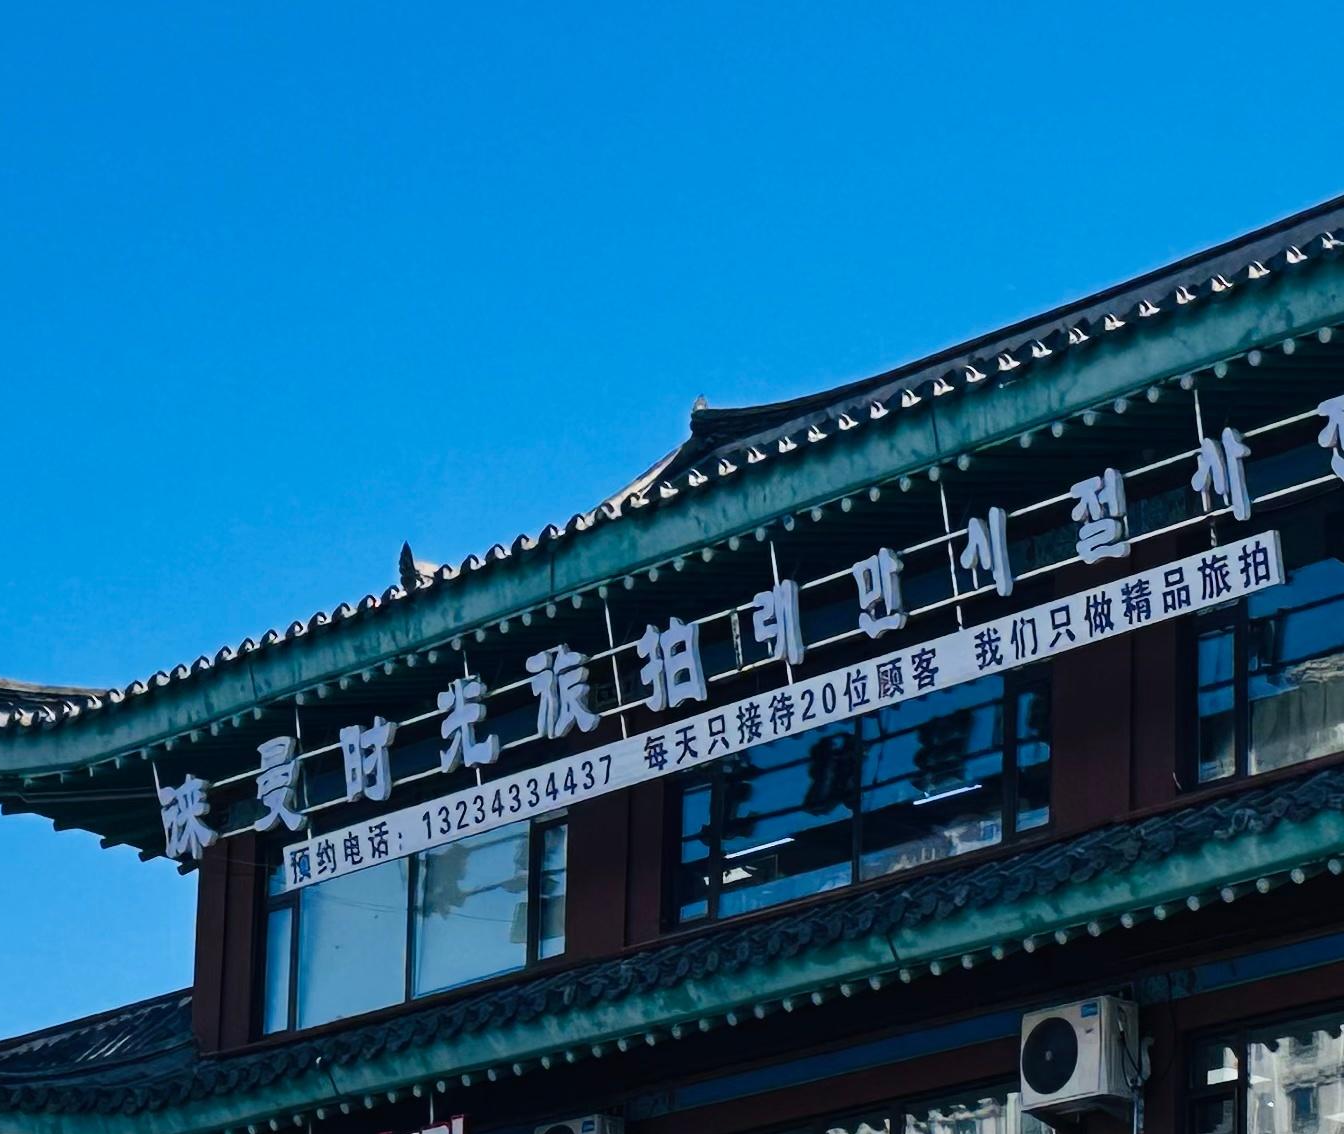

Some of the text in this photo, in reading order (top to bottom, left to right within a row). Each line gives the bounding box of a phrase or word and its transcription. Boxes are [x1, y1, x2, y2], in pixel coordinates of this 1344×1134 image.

[421, 754, 615, 841] 13234334437
[643, 646, 940, 772] 每天只接待20位顾客
[973, 543, 1272, 672] 我们只做精品旅拍
